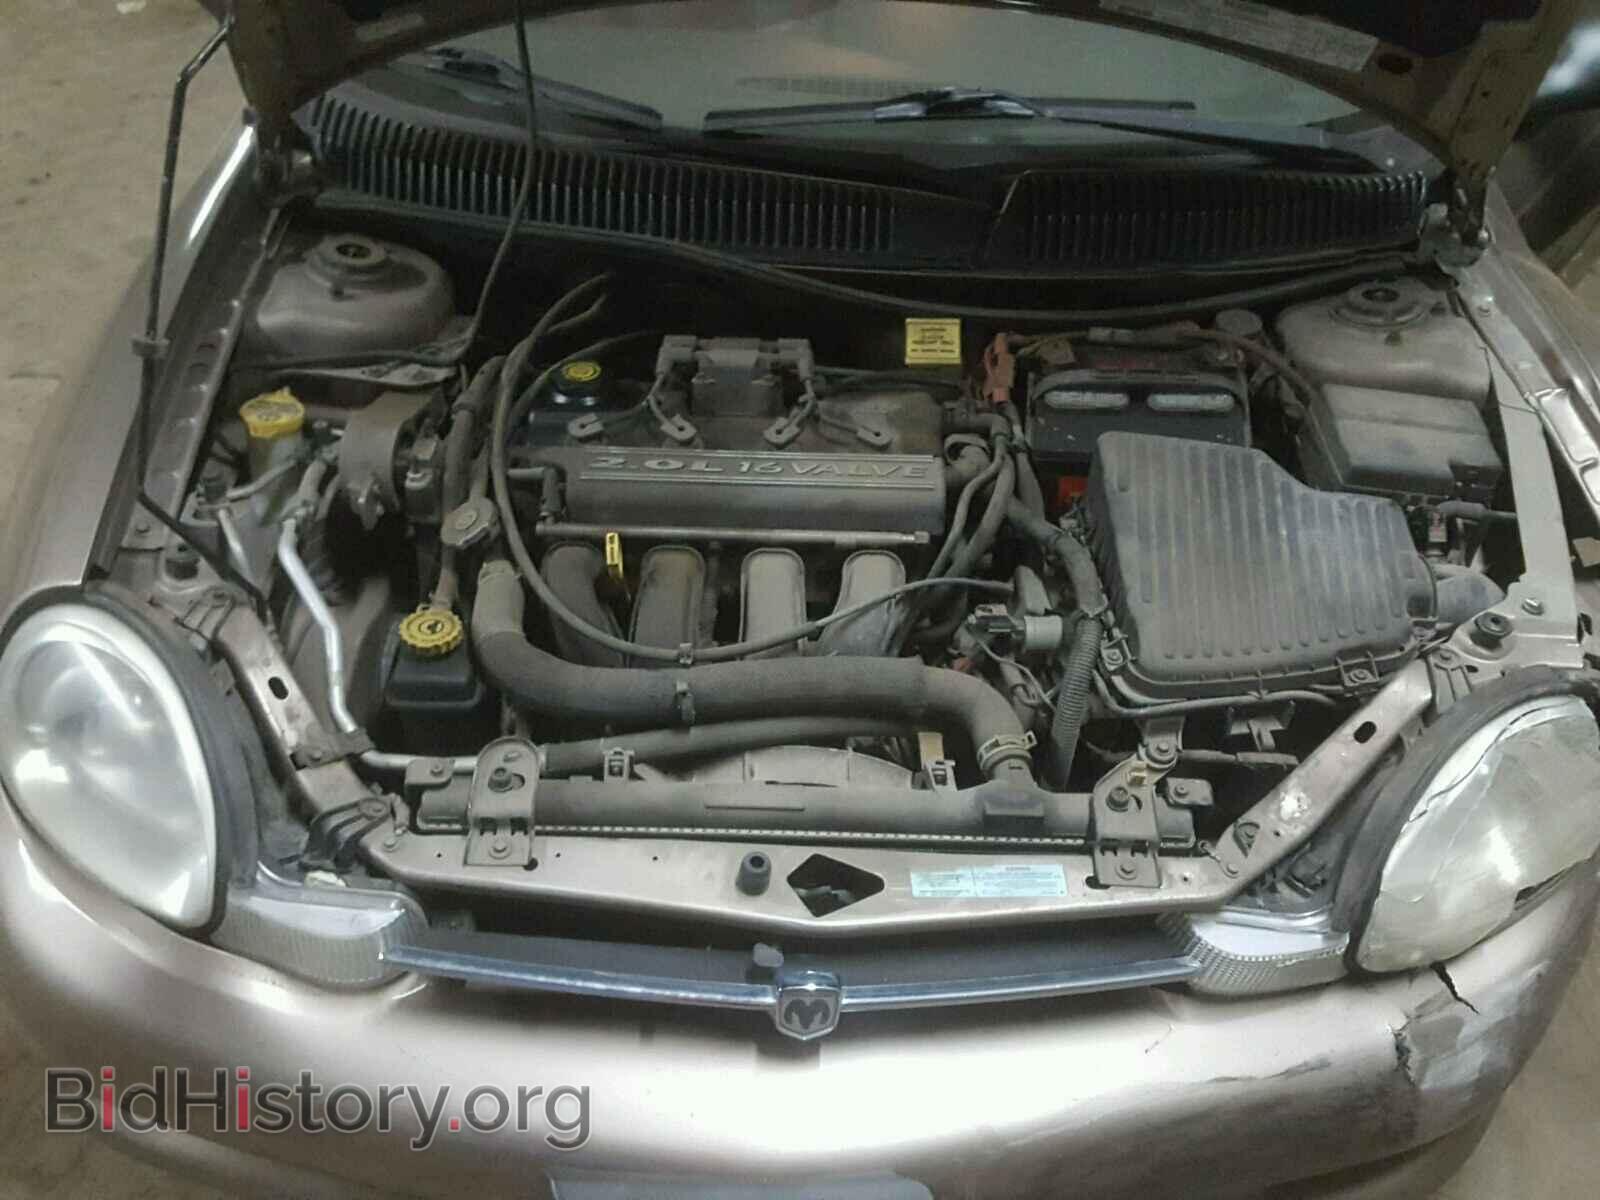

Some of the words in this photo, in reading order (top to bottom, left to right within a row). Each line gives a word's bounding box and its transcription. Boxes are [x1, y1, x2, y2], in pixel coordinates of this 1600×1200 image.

[589, 455, 725, 473] 2.0L
[738, 460, 785, 474] 16
[791, 462, 927, 478] VALVE
